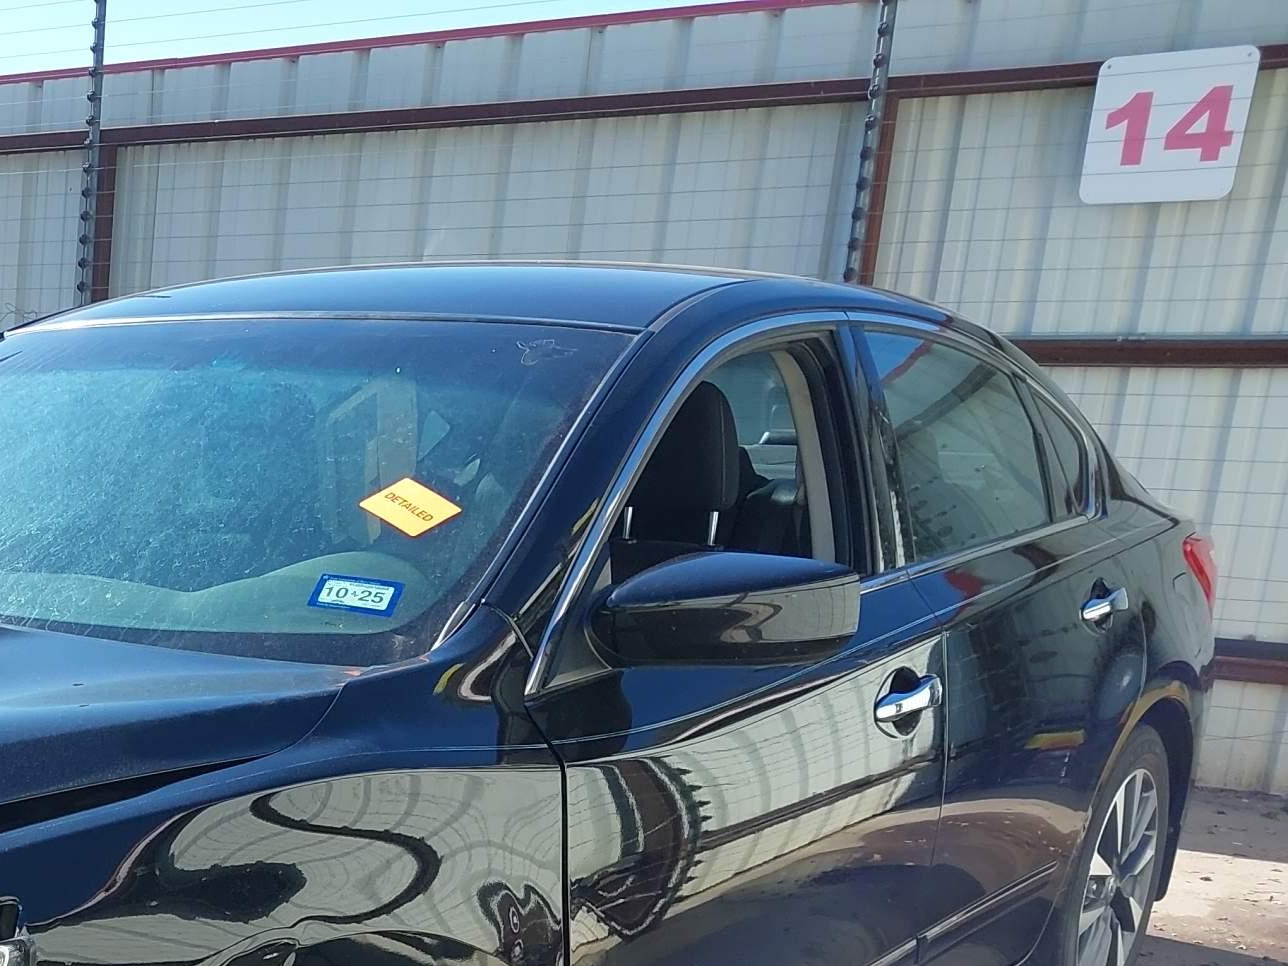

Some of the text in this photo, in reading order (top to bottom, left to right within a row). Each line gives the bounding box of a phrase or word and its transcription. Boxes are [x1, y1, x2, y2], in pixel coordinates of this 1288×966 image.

[1105, 84, 1235, 167] 14
[384, 491, 434, 522] DETAILED
[325, 586, 349, 599] 10
[358, 589, 386, 604] 25
